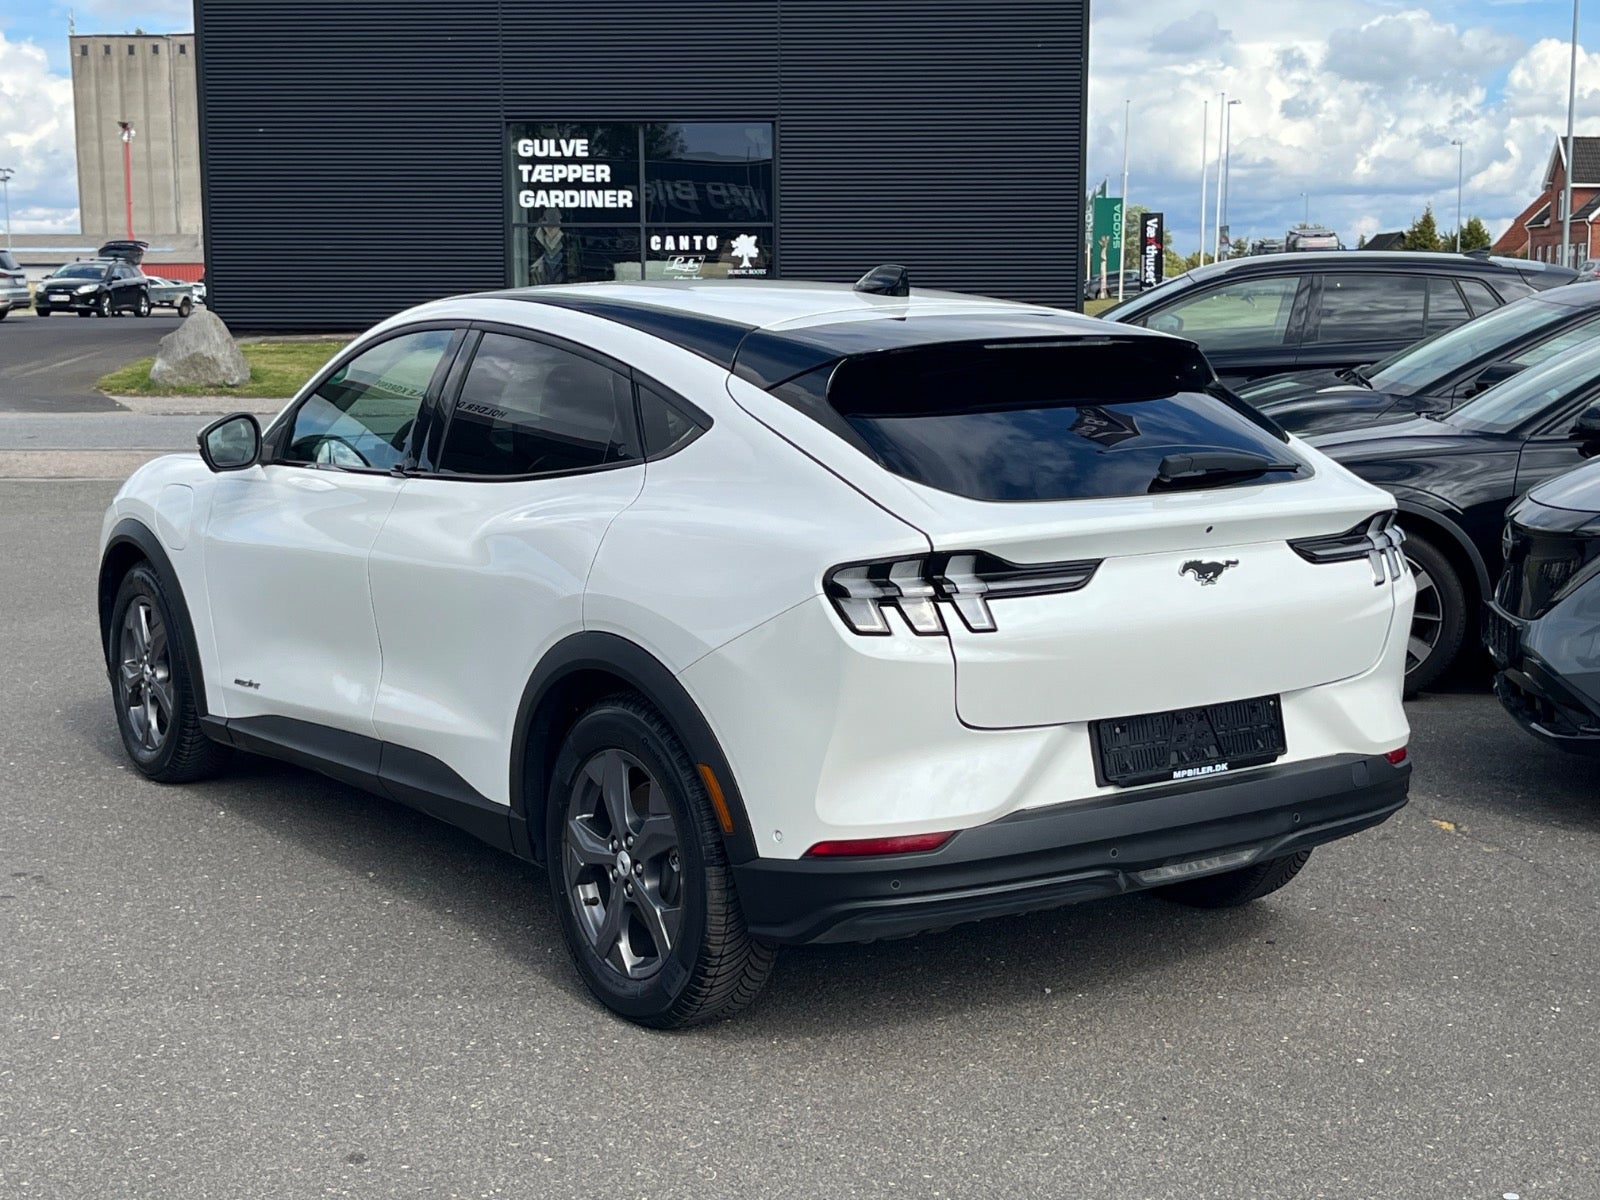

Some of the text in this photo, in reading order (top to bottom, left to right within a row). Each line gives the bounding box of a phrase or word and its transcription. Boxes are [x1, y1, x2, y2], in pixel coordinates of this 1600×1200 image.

[517, 138, 589, 157] GULVE
[518, 165, 611, 182] TÆPPER
[519, 190, 633, 208] GARDINER
[650, 235, 717, 251] CANTO
[1173, 762, 1228, 779] MPBILER.DK
